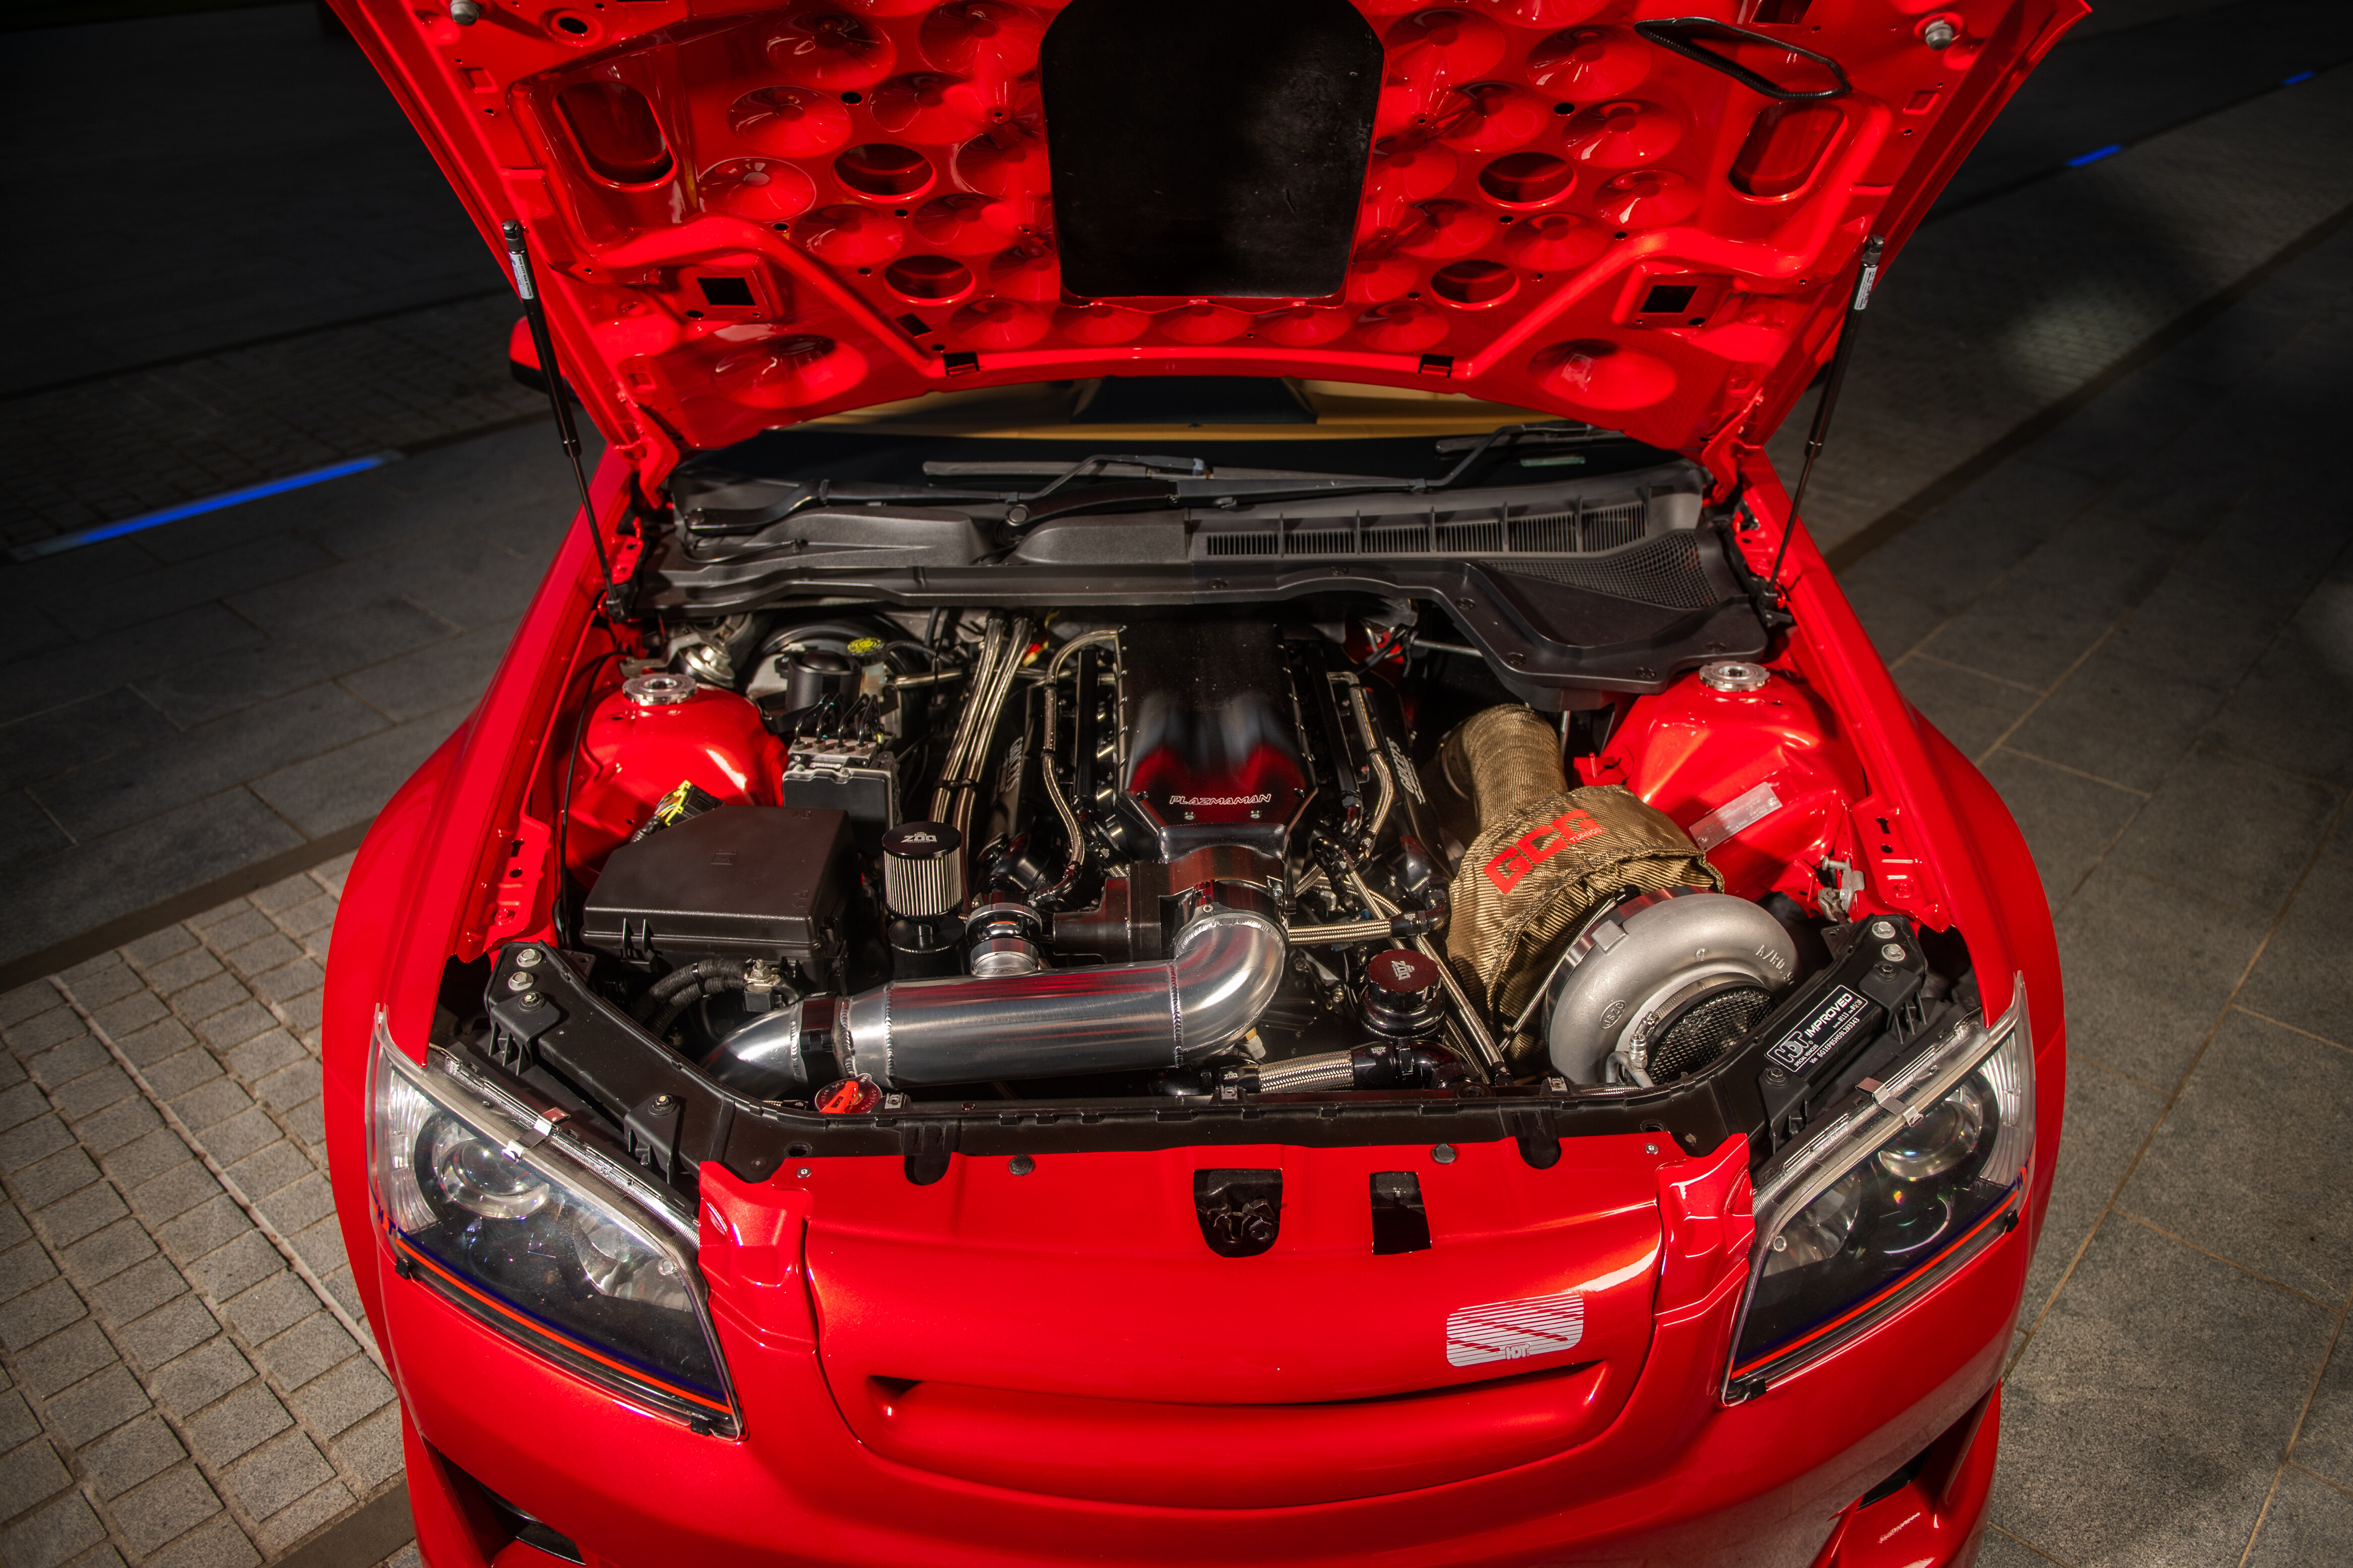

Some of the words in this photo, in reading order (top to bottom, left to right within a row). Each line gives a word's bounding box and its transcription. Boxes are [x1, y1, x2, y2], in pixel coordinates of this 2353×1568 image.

[1169, 793, 1271, 805] PLAZMAMAN
[901, 835, 938, 843] ZOO
[1569, 827, 1603, 842] TURBOS
[1483, 808, 1605, 895] GCG
[1391, 960, 1411, 980] ZOO
[1604, 1003, 1624, 1026] JSZC
[1804, 992, 1854, 1038] IMPROVED
[1837, 1011, 1850, 1022] 0113
[1850, 999, 1863, 1010] 05/20
[1774, 1030, 1810, 1063] HDT
[1794, 1056, 1807, 1067] SPECIAL
[1805, 1043, 1819, 1058] VEHICLES
[1504, 1343, 1530, 1360] HDT
